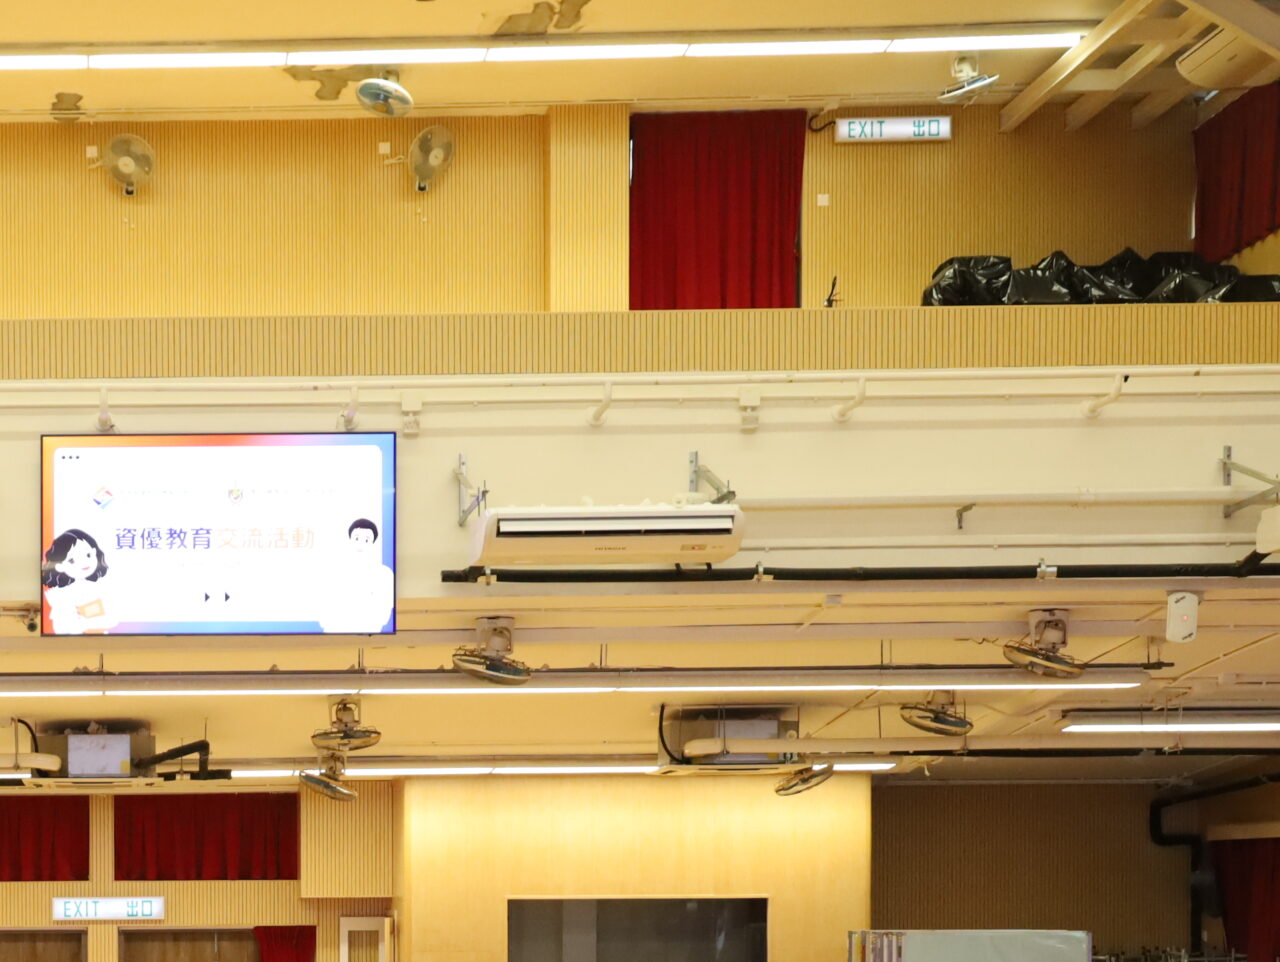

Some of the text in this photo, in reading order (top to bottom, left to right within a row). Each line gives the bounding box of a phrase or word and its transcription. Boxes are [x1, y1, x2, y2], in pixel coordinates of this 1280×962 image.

[848, 120, 885, 138] EXIT
[913, 119, 940, 137] 出口
[115, 527, 315, 550] 資優教育交流活動
[64, 901, 99, 918] EXIT
[127, 900, 153, 917] 出口
